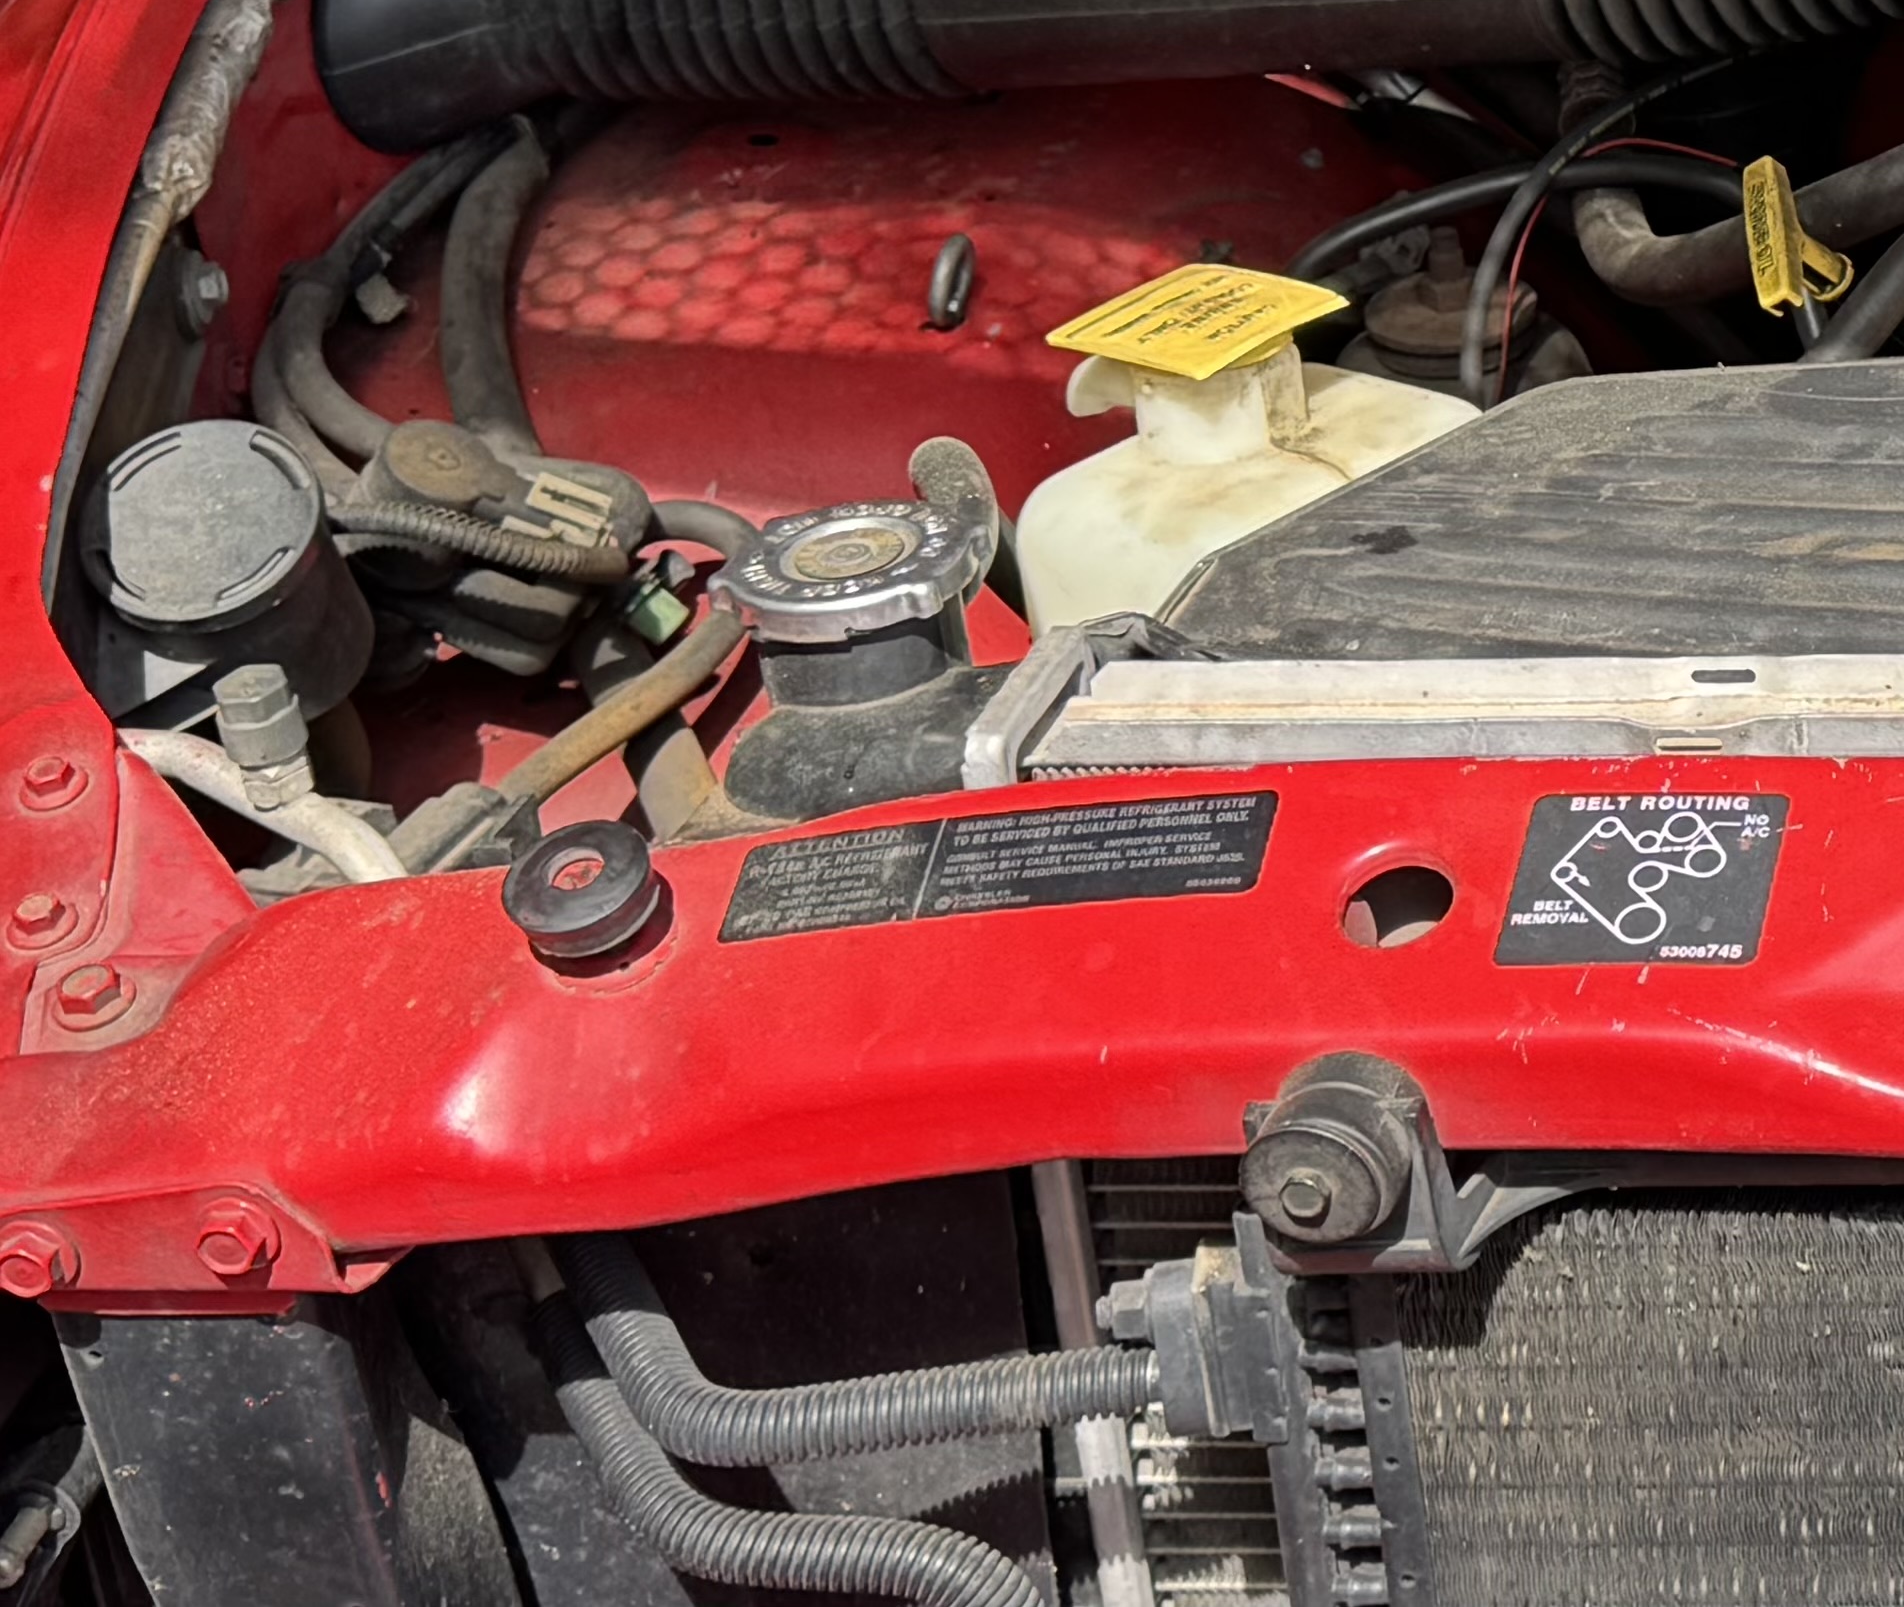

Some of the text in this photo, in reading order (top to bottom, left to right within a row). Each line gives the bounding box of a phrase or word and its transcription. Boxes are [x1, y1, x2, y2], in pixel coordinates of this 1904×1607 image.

[1119, 800, 1203, 817] REFRIGERANT
[1206, 796, 1257, 810] SYSTEM
[1569, 795, 1751, 812] BELT ROUTING
[1743, 813, 1770, 826] NO
[954, 835, 970, 847] TO
[972, 833, 988, 844] BE
[990, 826, 1051, 842] SERVICED
[1053, 824, 1071, 836] BY
[1073, 818, 1137, 834] QUALIFIED
[1138, 814, 1213, 829] PERSONNEL
[1740, 825, 1771, 839] A/C
[1025, 854, 1061, 866] CAUSE
[1152, 854, 1215, 867] STANDARD
[1532, 899, 1574, 912] BELT
[1510, 911, 1589, 926] REMOVAL
